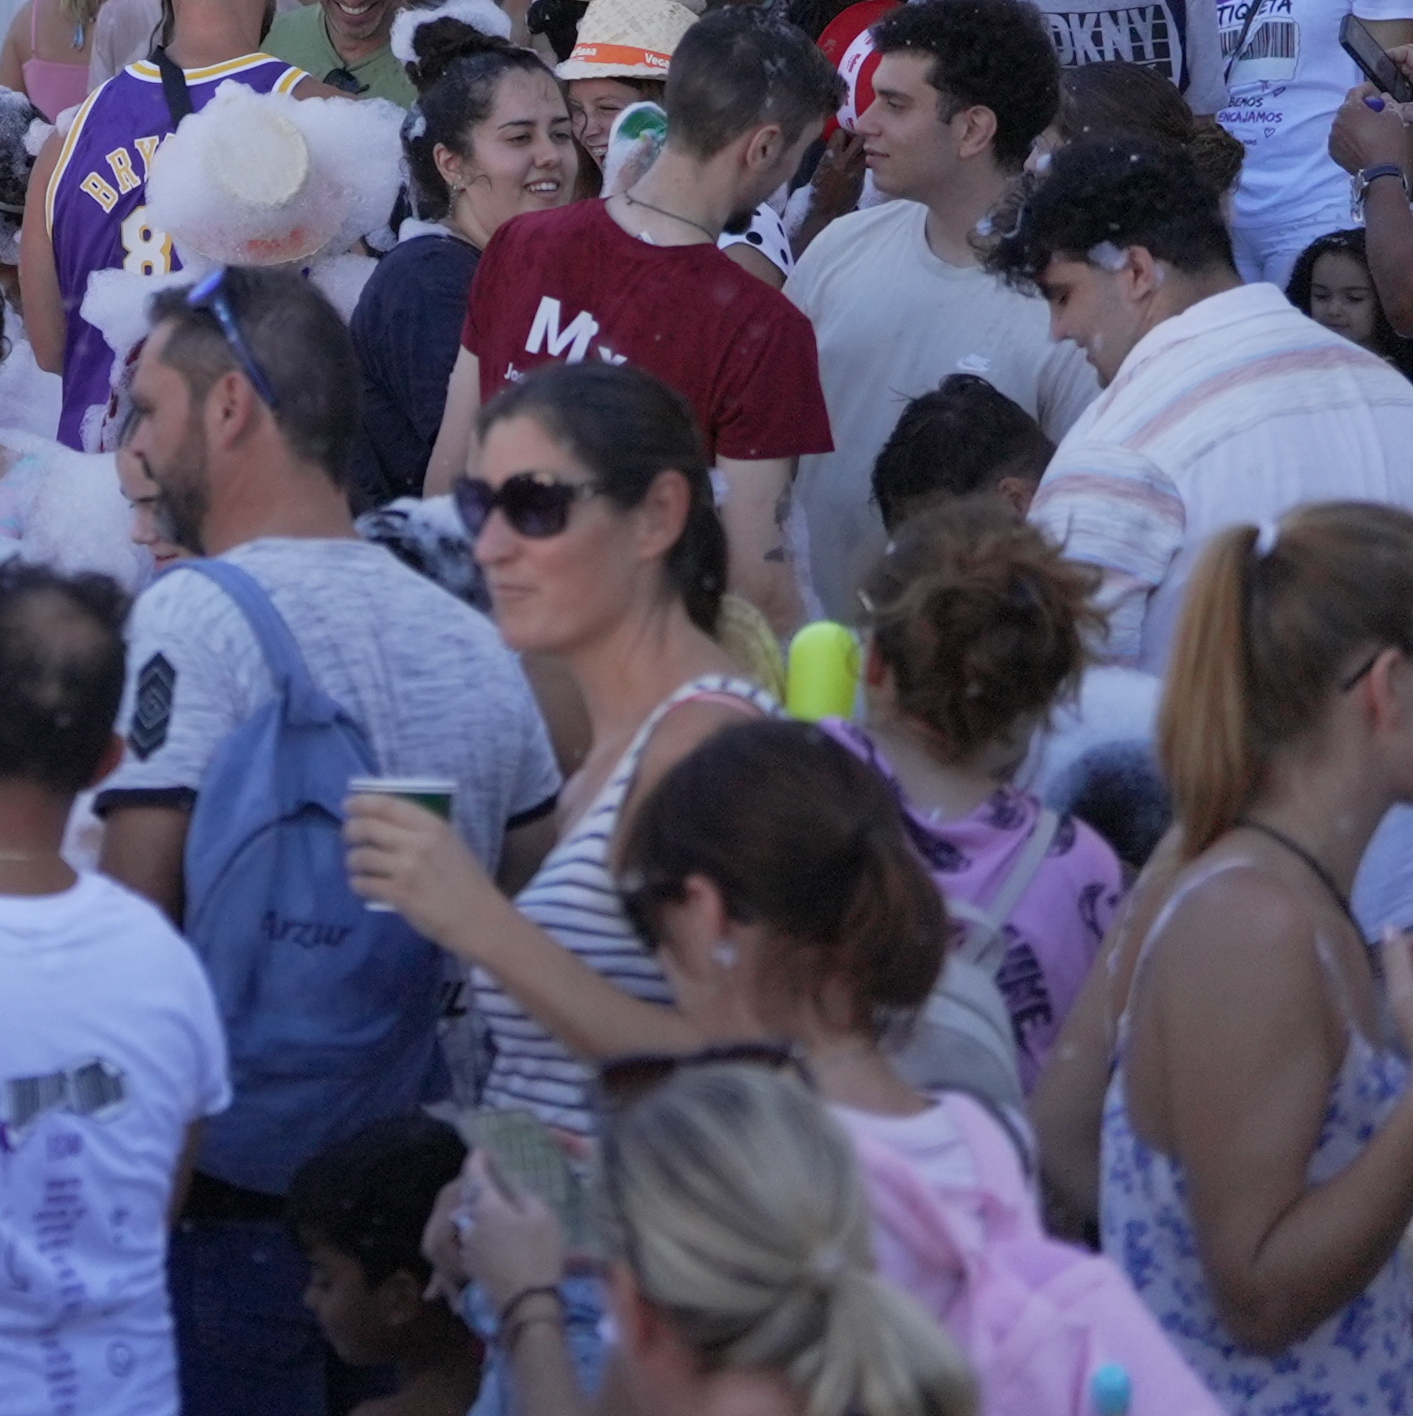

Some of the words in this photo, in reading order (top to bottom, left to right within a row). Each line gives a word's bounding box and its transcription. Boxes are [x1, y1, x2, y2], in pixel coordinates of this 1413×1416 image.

[1044, 5, 1155, 67] DKNY
[80, 132, 176, 214] BRY
[120, 205, 173, 276] 8
